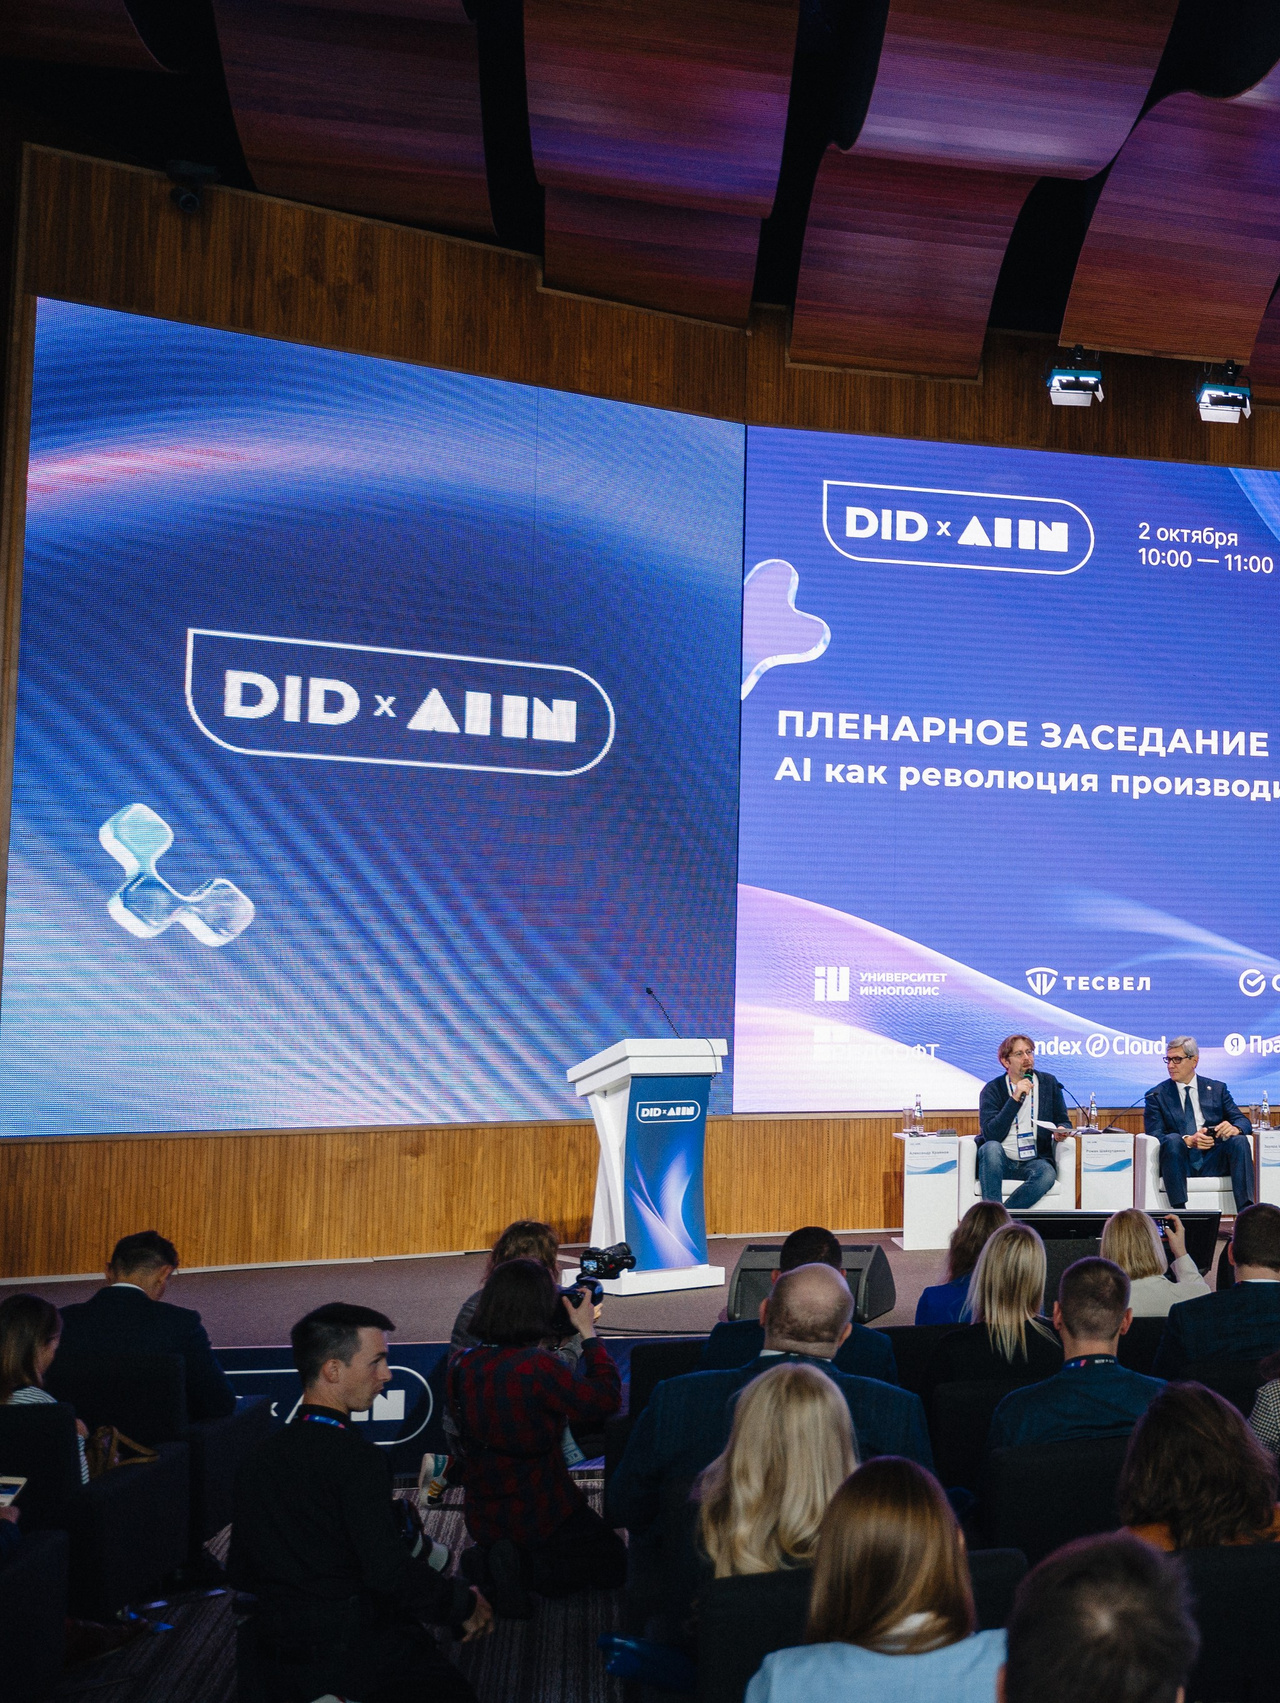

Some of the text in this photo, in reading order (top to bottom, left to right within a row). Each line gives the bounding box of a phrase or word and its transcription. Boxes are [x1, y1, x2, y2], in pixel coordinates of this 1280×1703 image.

[845, 506, 929, 542] DID
[1138, 522, 1239, 549] 2 октября
[1138, 547, 1193, 568] 10:00
[1224, 553, 1274, 574] 11:00
[223, 669, 361, 726] DID
[777, 709, 1269, 758] ПЛЕНАРНОЕ ЗАСЕДАНИЕ
[773, 756, 811, 782] AI
[825, 763, 888, 785] как
[899, 766, 1099, 795] революция
[859, 972, 948, 984] УНИВЕРСИТЕТ
[859, 985, 941, 996] ИННОПОЛИС
[1062, 975, 1151, 991] ТЕСВЕЛ
[1034, 1035, 1167, 1056] ndex Cloud
[640, 1107, 662, 1118] DID
